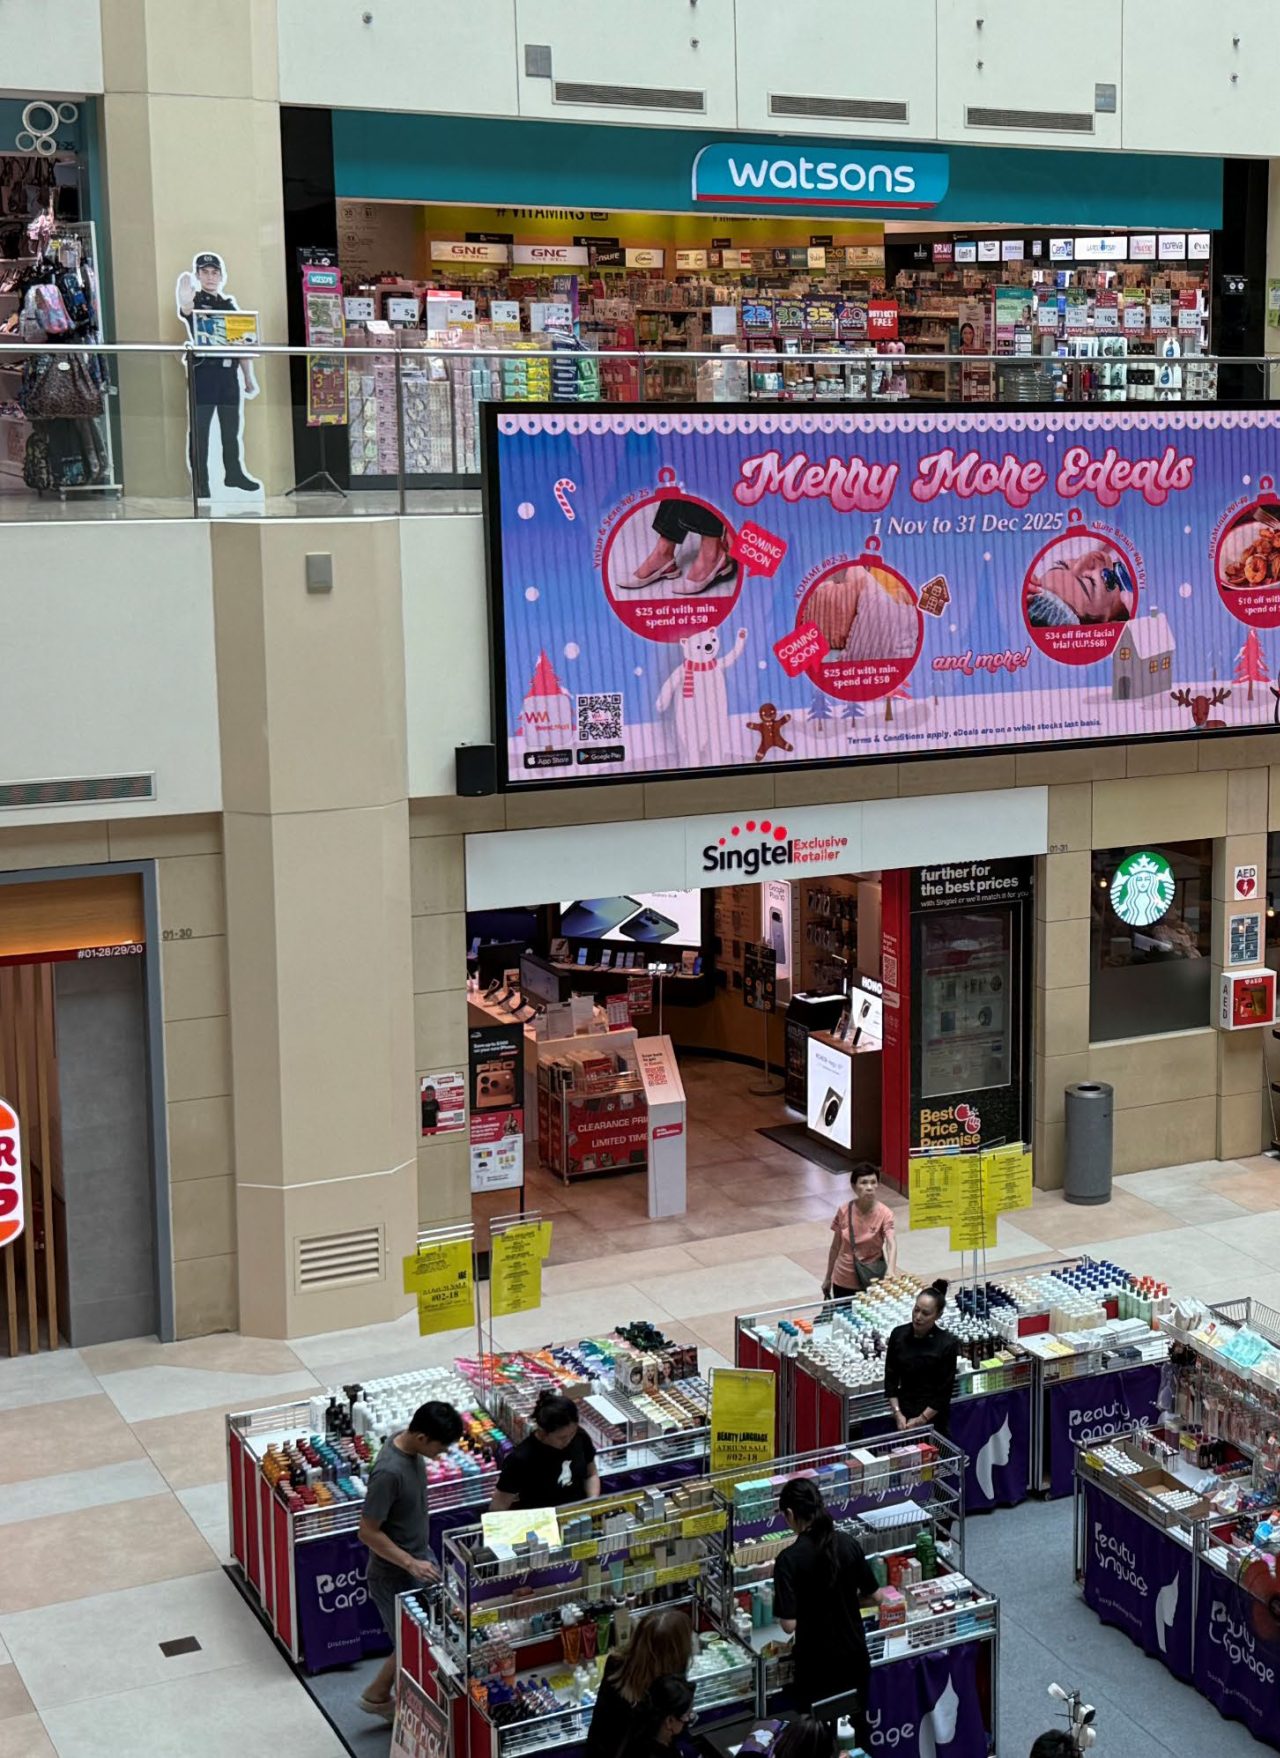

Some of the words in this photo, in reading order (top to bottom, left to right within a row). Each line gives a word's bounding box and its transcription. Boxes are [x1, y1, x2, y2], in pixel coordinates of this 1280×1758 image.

[728, 157, 916, 193] watsons
[452, 246, 489, 255] GNC
[531, 248, 568, 258] GNC
[732, 448, 899, 513] Merry
[910, 446, 1047, 509] More
[1056, 444, 1195, 507] Edeals
[873, 519, 881, 536] 1
[888, 517, 927, 535] Nov
[932, 517, 951, 534] to
[958, 516, 975, 533] 31
[981, 515, 1017, 532] Dec
[1023, 512, 1064, 531] 2025
[741, 529, 782, 559] COMING
[740, 545, 772, 569] SOON
[635, 607, 653, 617] $25
[656, 606, 670, 616] off
[671, 605, 695, 614] with
[697, 604, 718, 614] min.
[646, 616, 676, 628] spend
[678, 616, 689, 625] of
[691, 615, 709, 625] $50
[778, 627, 820, 660] COMING
[789, 641, 821, 668] SOON
[932, 650, 973, 677] and
[975, 646, 1032, 677] more!
[823, 668, 840, 677] $25
[843, 667, 856, 677] off
[858, 666, 876, 676] with
[878, 665, 899, 675] min.
[833, 677, 860, 689] spend
[862, 675, 872, 684] of
[847, 736, 872, 745] Terms
[883, 732, 925, 742] Conditions
[1013, 723, 1036, 732] while
[537, 757, 552, 767] App
[703, 838, 793, 875] Singtel
[793, 836, 848, 850] Exclusive
[793, 850, 841, 864] Retailer
[921, 867, 969, 882] further
[971, 864, 990, 877] for
[1237, 867, 1256, 879] AED
[921, 883, 943, 896] the
[945, 881, 974, 894] best
[976, 876, 1019, 893] prices
[921, 900, 935, 908] with
[935, 898, 957, 907] Singtel
[981, 893, 1001, 902] match
[162, 929, 192, 940] 01-30
[77, 944, 143, 959] #01-28/29/30
[476, 1060, 516, 1074] PRO
[920, 1105, 954, 1124] Best
[577, 1119, 630, 1133] CLEARANCE
[920, 1121, 958, 1138] Price
[592, 1136, 626, 1149] LIMITED
[920, 1133, 980, 1148] Promise
[432, 1291, 459, 1302] #02-18
[1068, 1398, 1131, 1427] Beauty
[717, 1431, 738, 1442] BEAUTY
[739, 1431, 768, 1442] LANGUAGE
